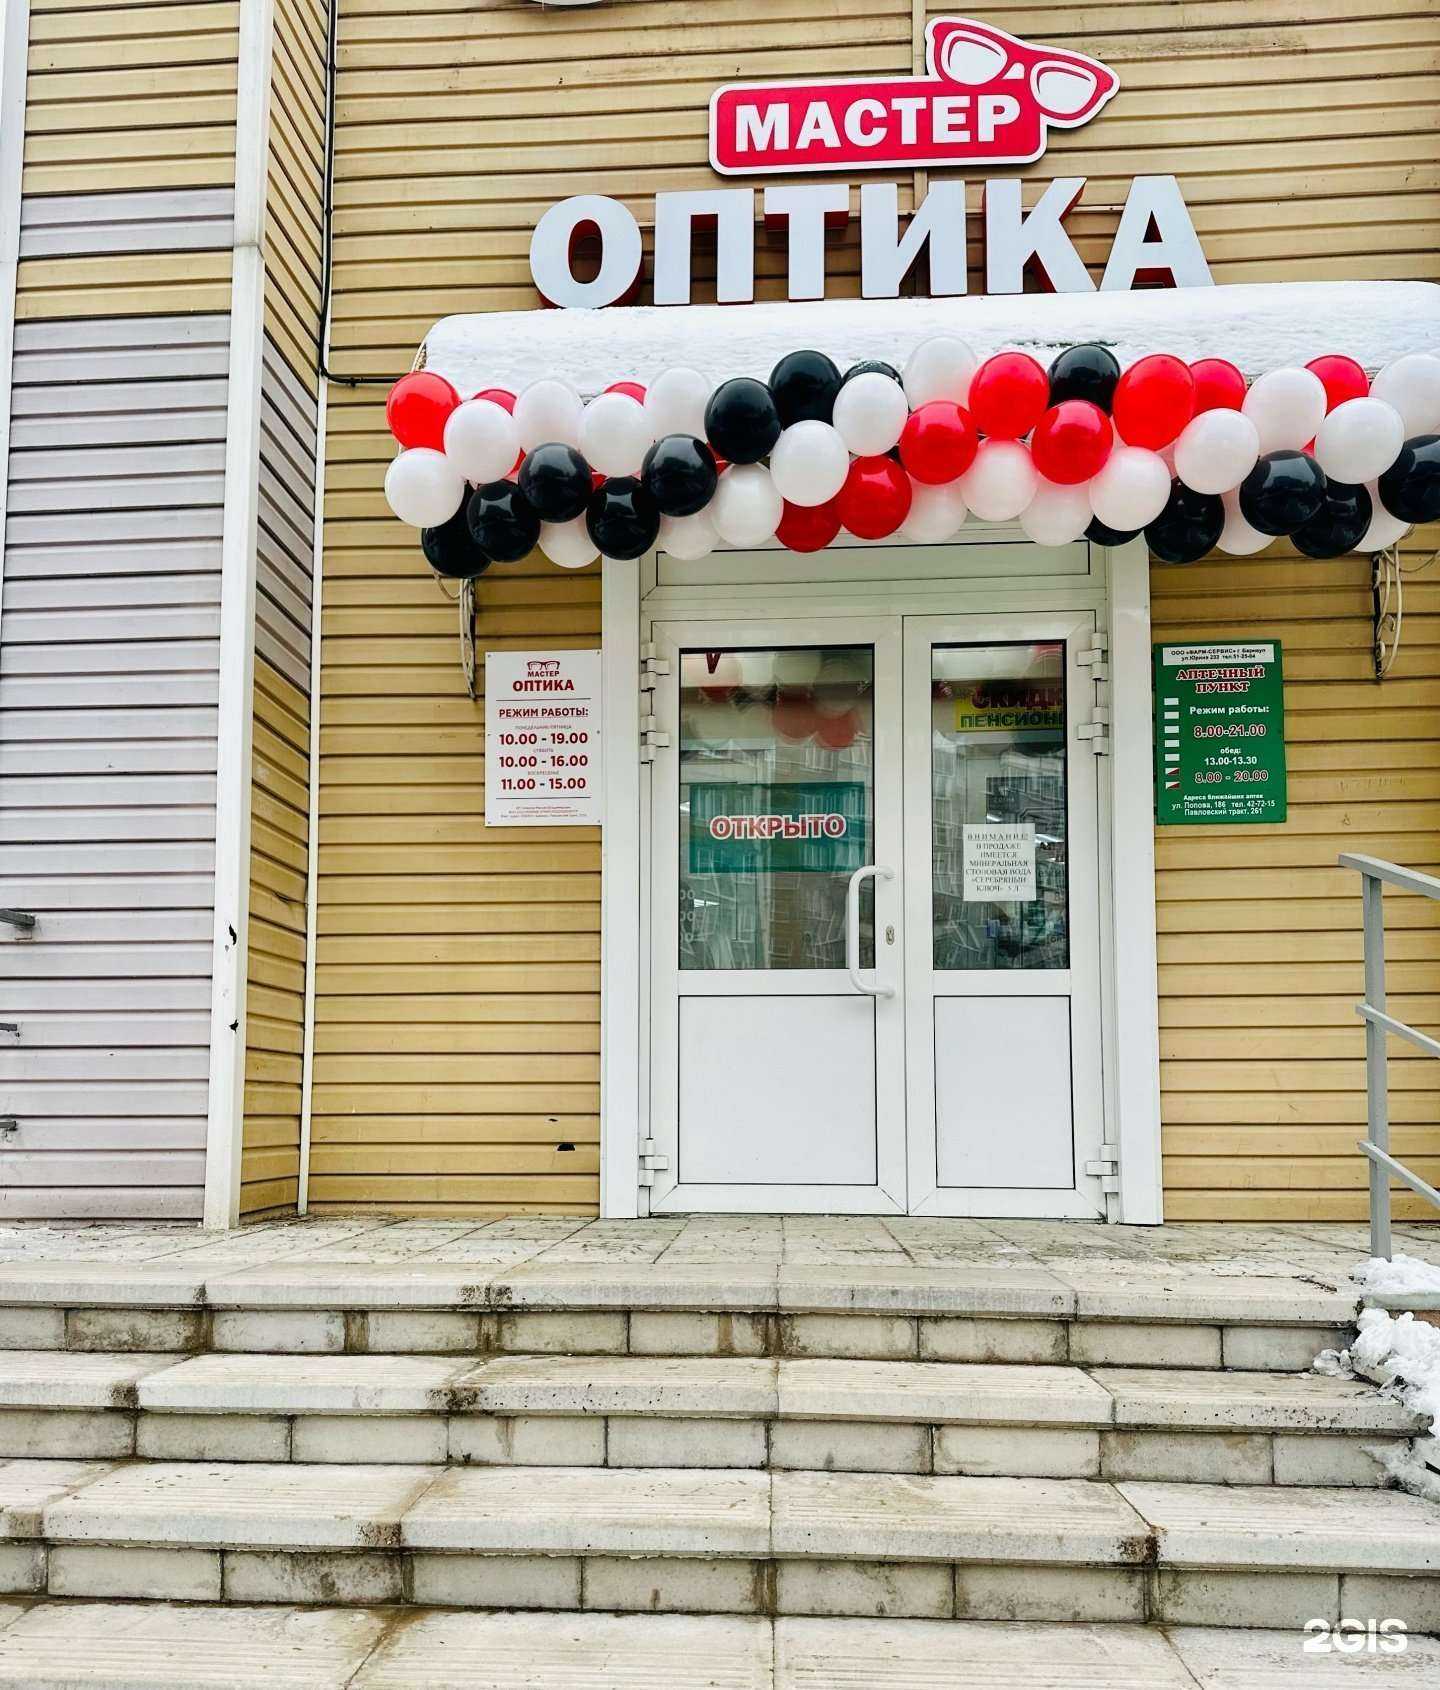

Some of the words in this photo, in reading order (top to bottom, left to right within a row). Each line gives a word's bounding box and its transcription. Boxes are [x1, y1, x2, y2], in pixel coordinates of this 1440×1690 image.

[734, 94, 1021, 153] МАСТЕР
[529, 174, 1216, 309] ОПТИКА
[1176, 664, 1265, 680] АПТЕЧНЫЙ
[512, 679, 575, 692] ОПТИКА
[1195, 681, 1250, 693] ПУНКТ
[499, 709, 539, 718] РЕЖИМ
[541, 707, 589, 717] РАБОТЫ:
[1189, 706, 1226, 715] Режим
[1228, 704, 1270, 716] работы:
[960, 712, 1063, 728] ПЕНСИОН
[1193, 724, 1266, 738] 8.00-21.00
[498, 733, 537, 745] 10.00
[550, 732, 588, 744] 19.00
[498, 756, 537, 768] 10.00
[550, 755, 588, 767] 16.00
[1204, 756, 1257, 766] 13.00-13.30
[1195, 771, 1222, 783] 8.00
[1233, 770, 1269, 782] 20.00
[501, 778, 536, 790] 11.00
[548, 777, 586, 790] 15.00
[1246, 800, 1276, 808] 42-72-15
[1184, 808, 1228, 816] Павловский
[1250, 807, 1263, 815] 261
[710, 814, 846, 840] ОТКРЫТО
